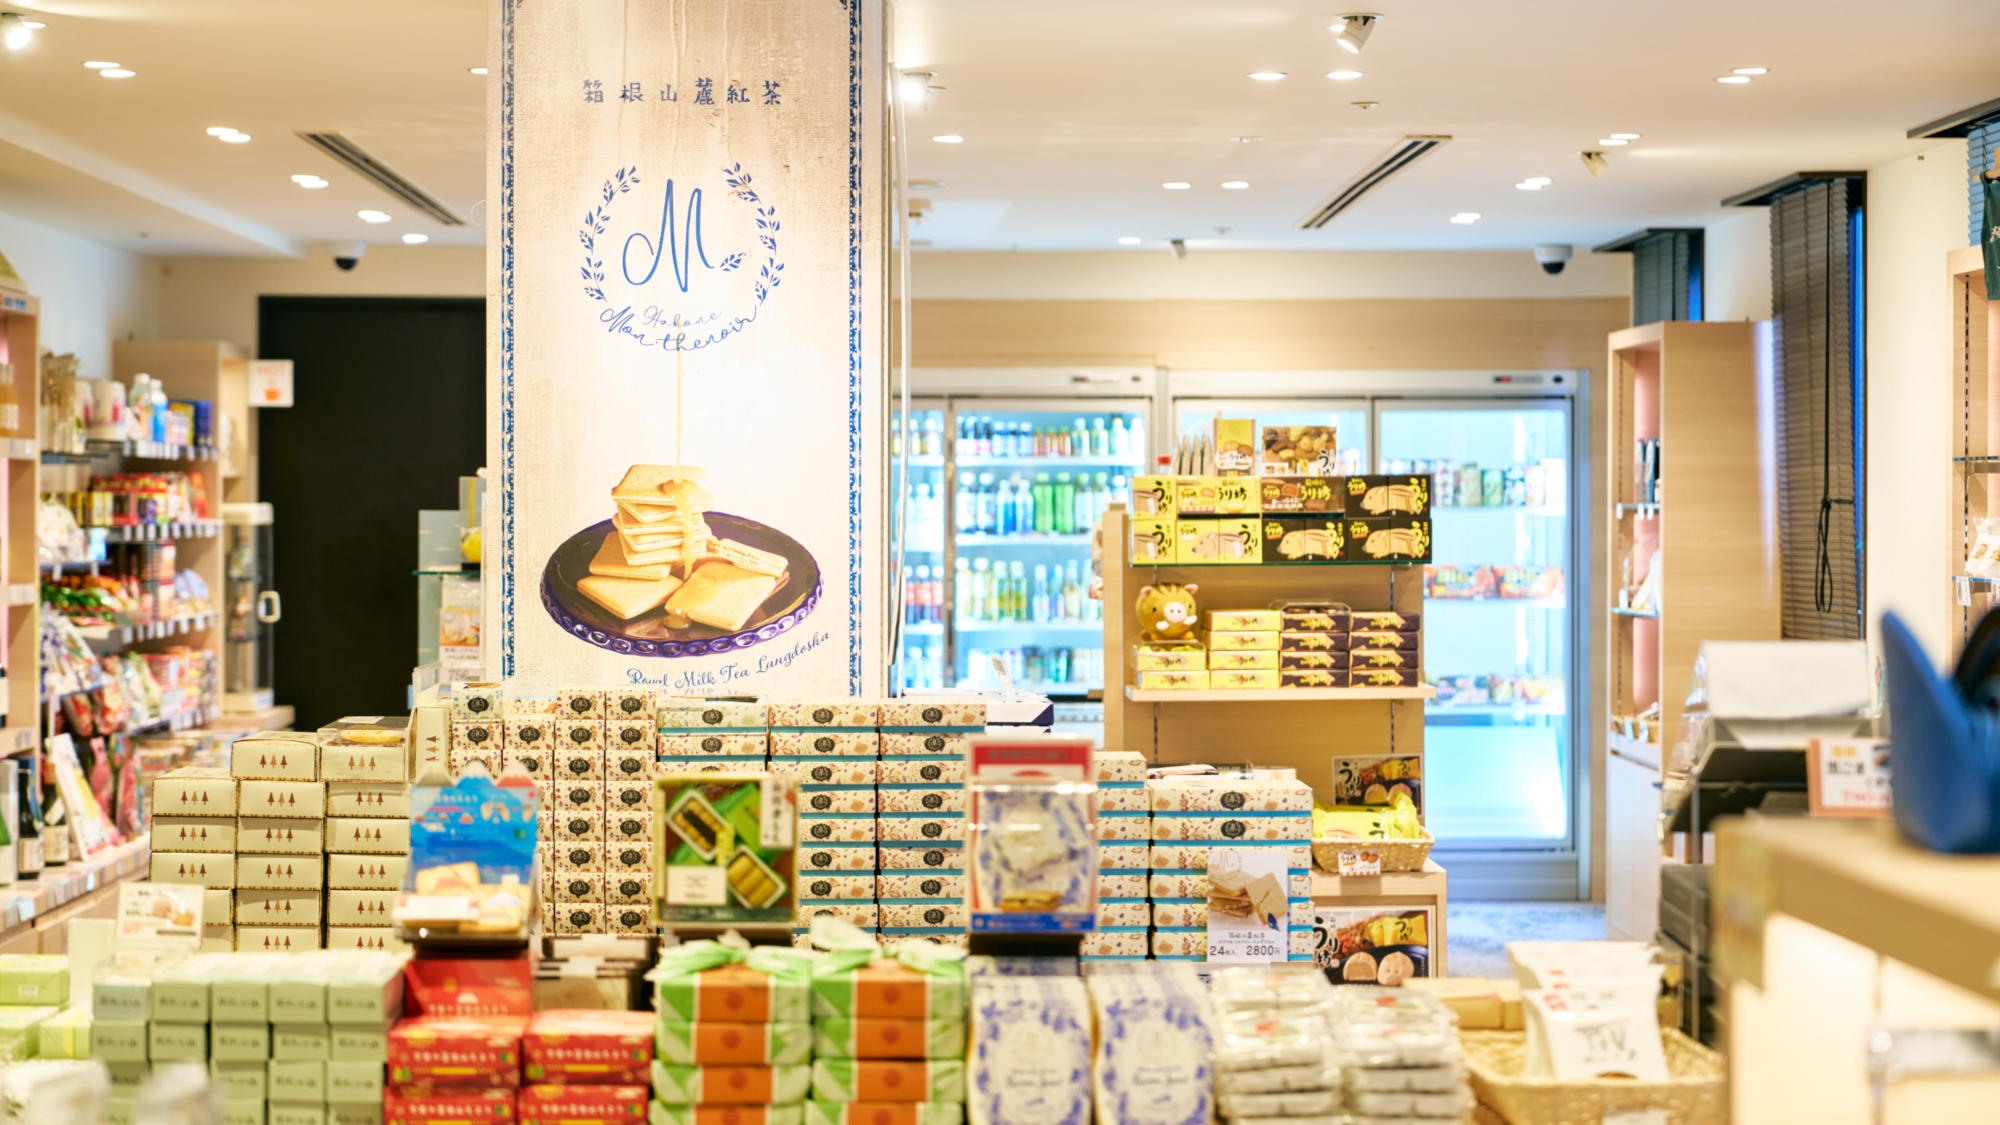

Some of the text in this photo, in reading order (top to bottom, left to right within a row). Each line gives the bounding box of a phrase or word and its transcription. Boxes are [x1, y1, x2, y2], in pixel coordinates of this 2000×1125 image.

[583, 77, 781, 105] 箱根山麓紅茶
[674, 671, 716, 689] Milk
[719, 664, 750, 683] Tea
